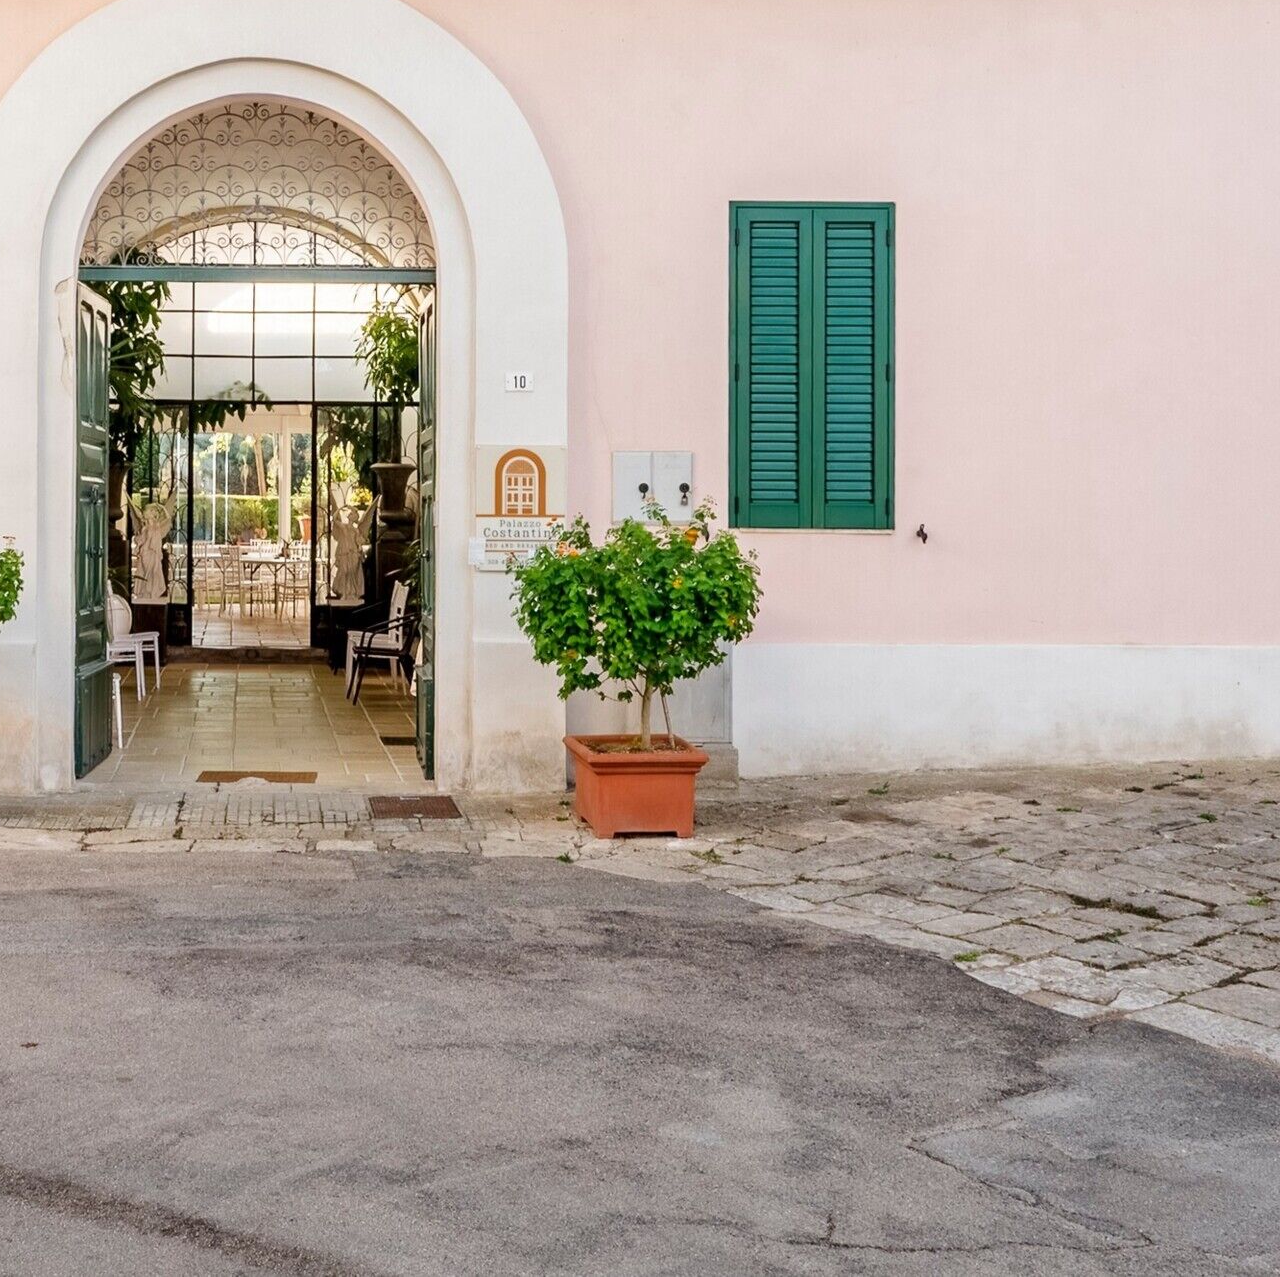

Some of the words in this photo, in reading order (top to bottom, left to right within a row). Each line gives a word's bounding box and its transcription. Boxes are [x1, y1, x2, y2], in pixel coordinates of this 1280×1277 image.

[513, 375, 526, 389] 10
[499, 519, 541, 528] Palazzo
[483, 527, 557, 538] Costantin
